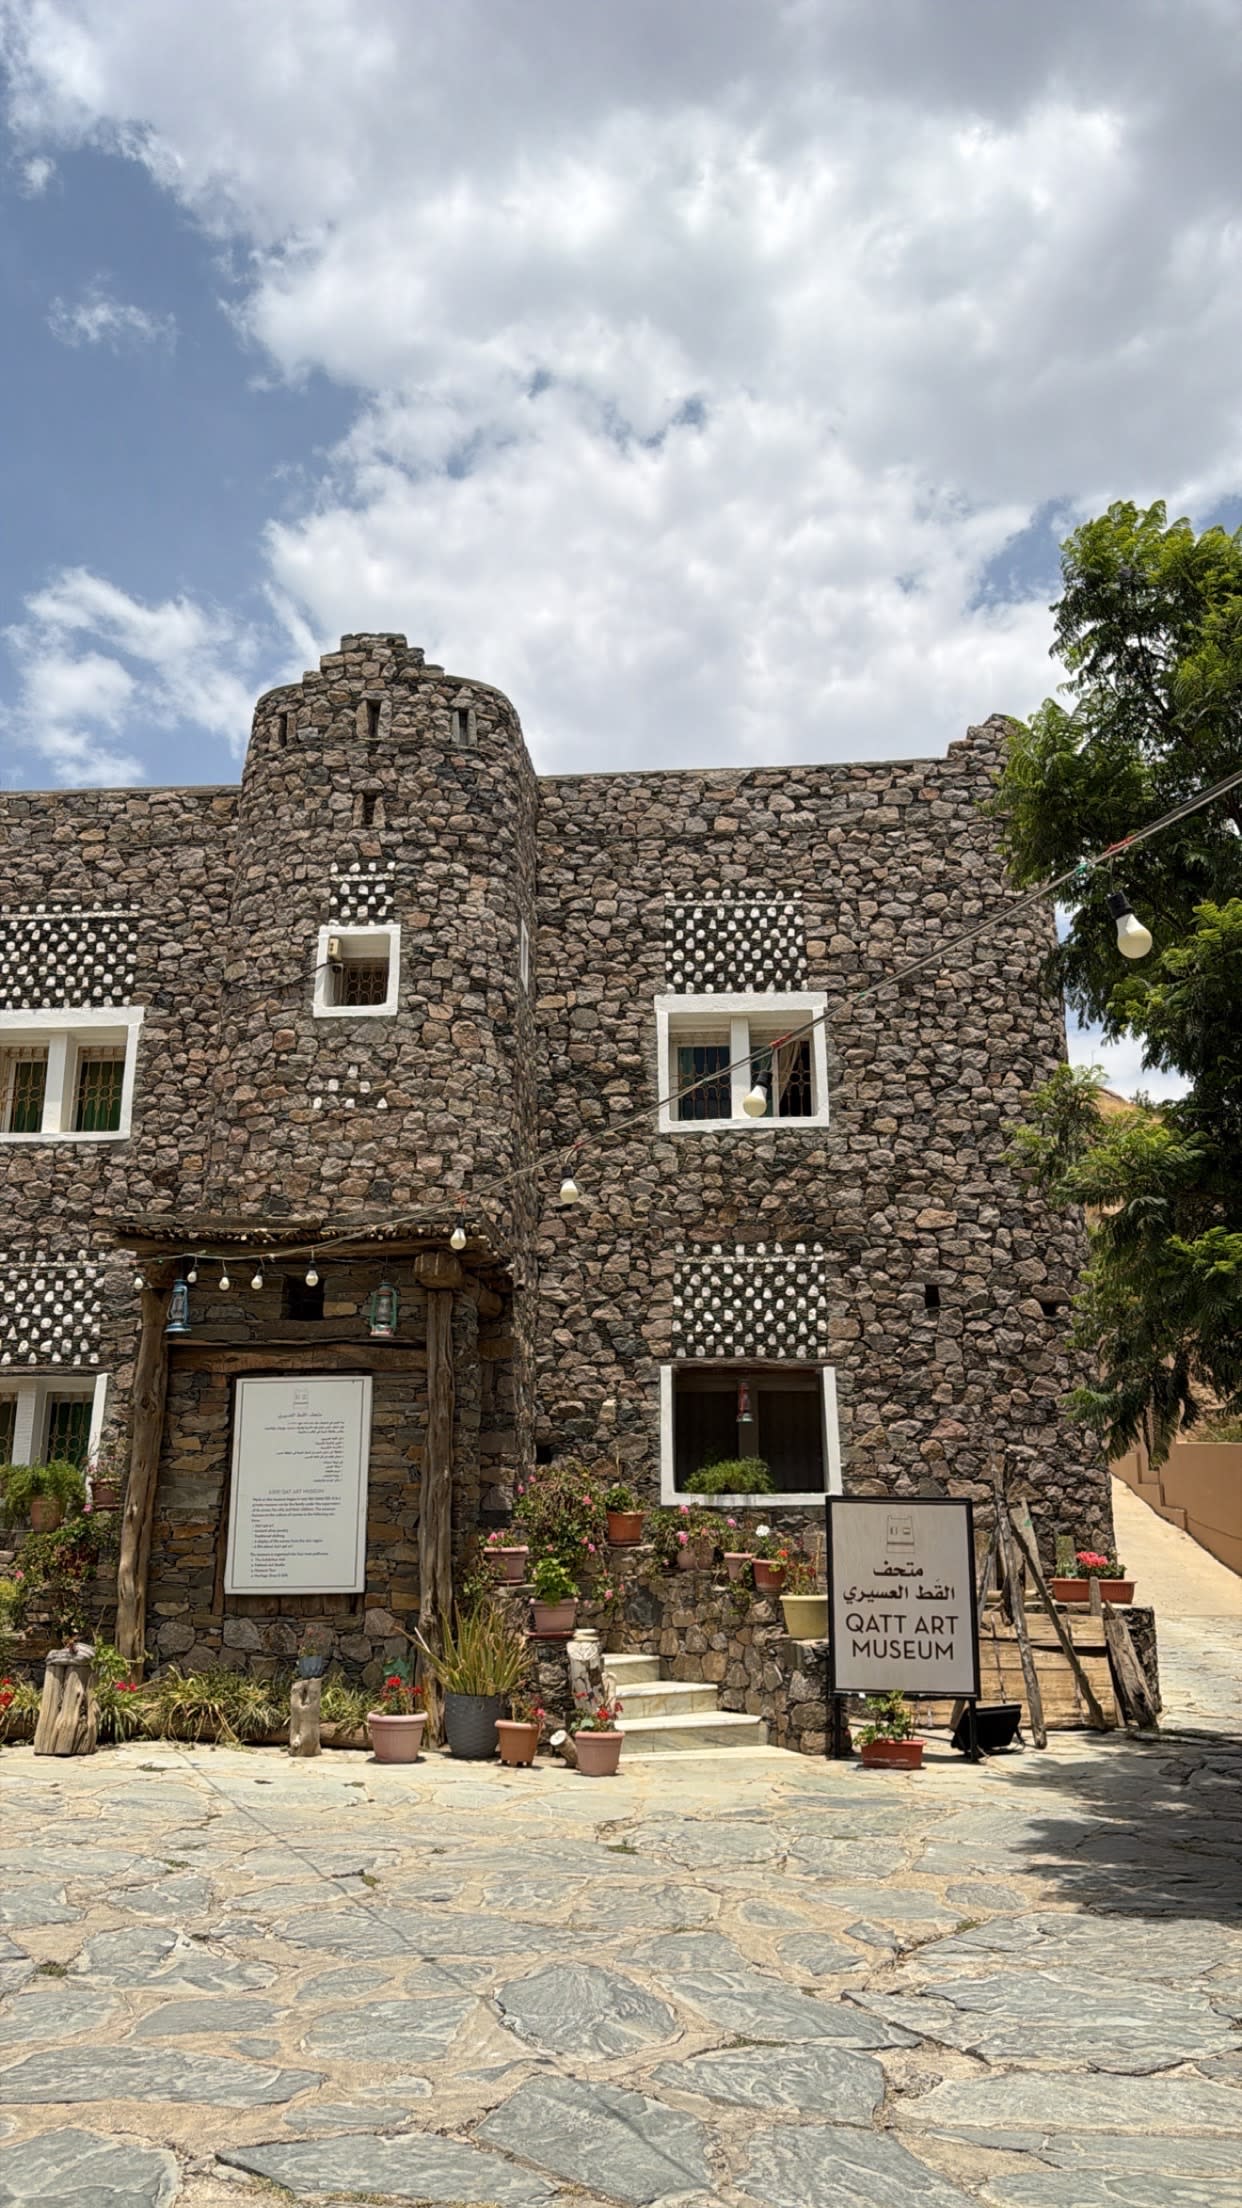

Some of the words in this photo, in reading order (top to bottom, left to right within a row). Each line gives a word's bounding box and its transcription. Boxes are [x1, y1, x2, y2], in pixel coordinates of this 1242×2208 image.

[873, 1560, 924, 1577] متحف
[843, 1584, 909, 1605] العسيري
[845, 1612, 907, 1634] QATT
[914, 1615, 960, 1636] ART
[852, 1639, 954, 1661] MUSEUM
